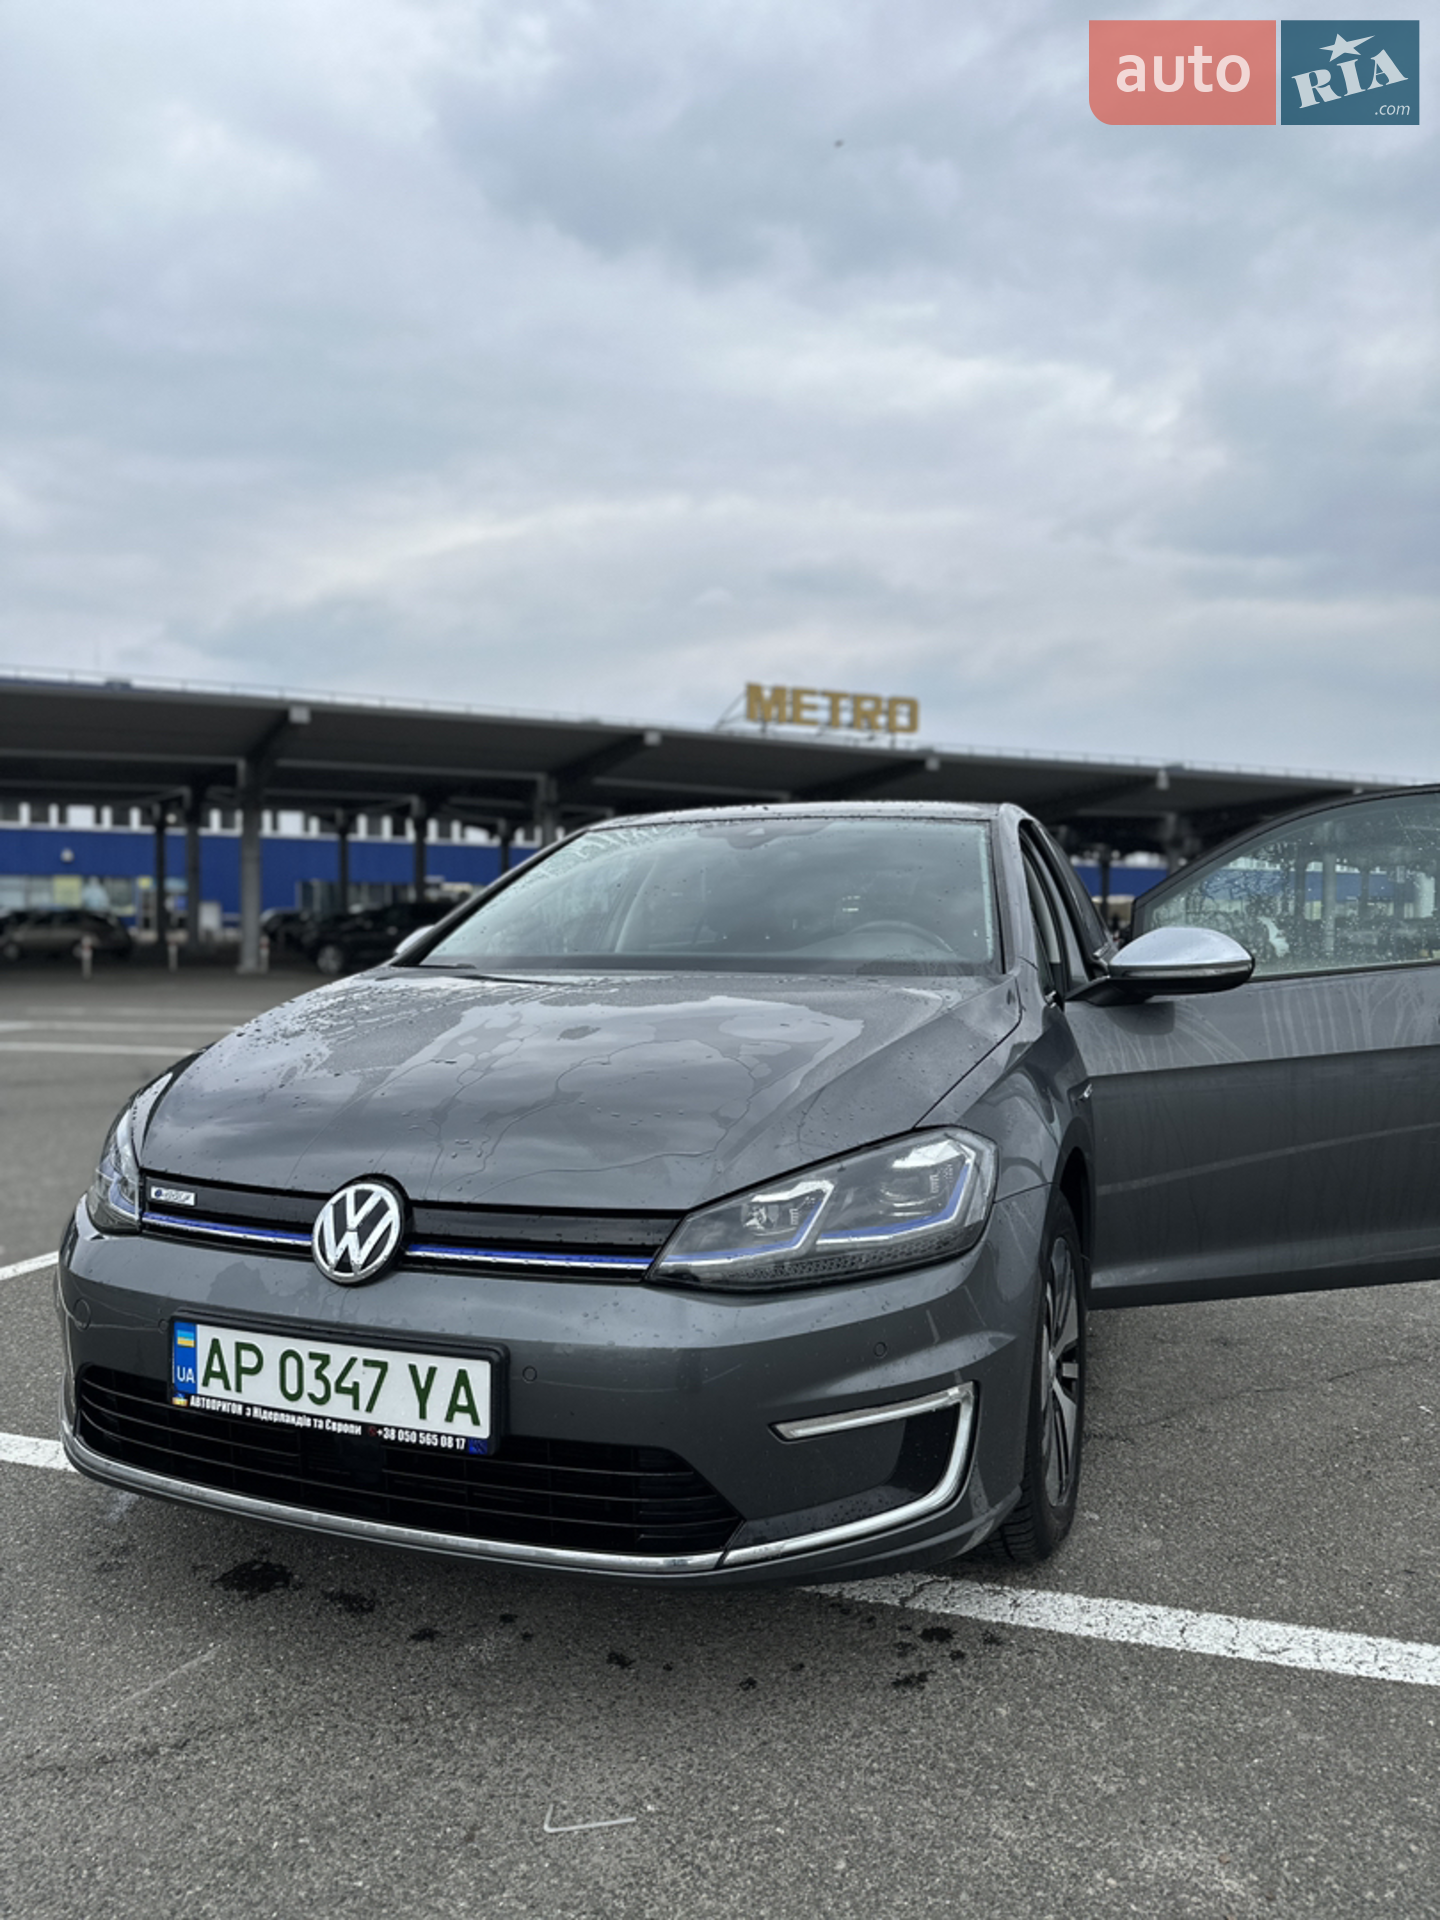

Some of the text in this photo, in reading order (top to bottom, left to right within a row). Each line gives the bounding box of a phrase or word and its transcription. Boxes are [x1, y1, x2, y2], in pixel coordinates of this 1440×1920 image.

[746, 683, 919, 733] METRO
[177, 1365, 195, 1384] UA
[202, 1337, 481, 1426] AP 0347 YA
[313, 1418, 324, 1429] та
[377, 1427, 396, 1440] +38
[398, 1429, 417, 1443] 050
[419, 1432, 438, 1446] 565
[455, 1437, 466, 1450] 17
